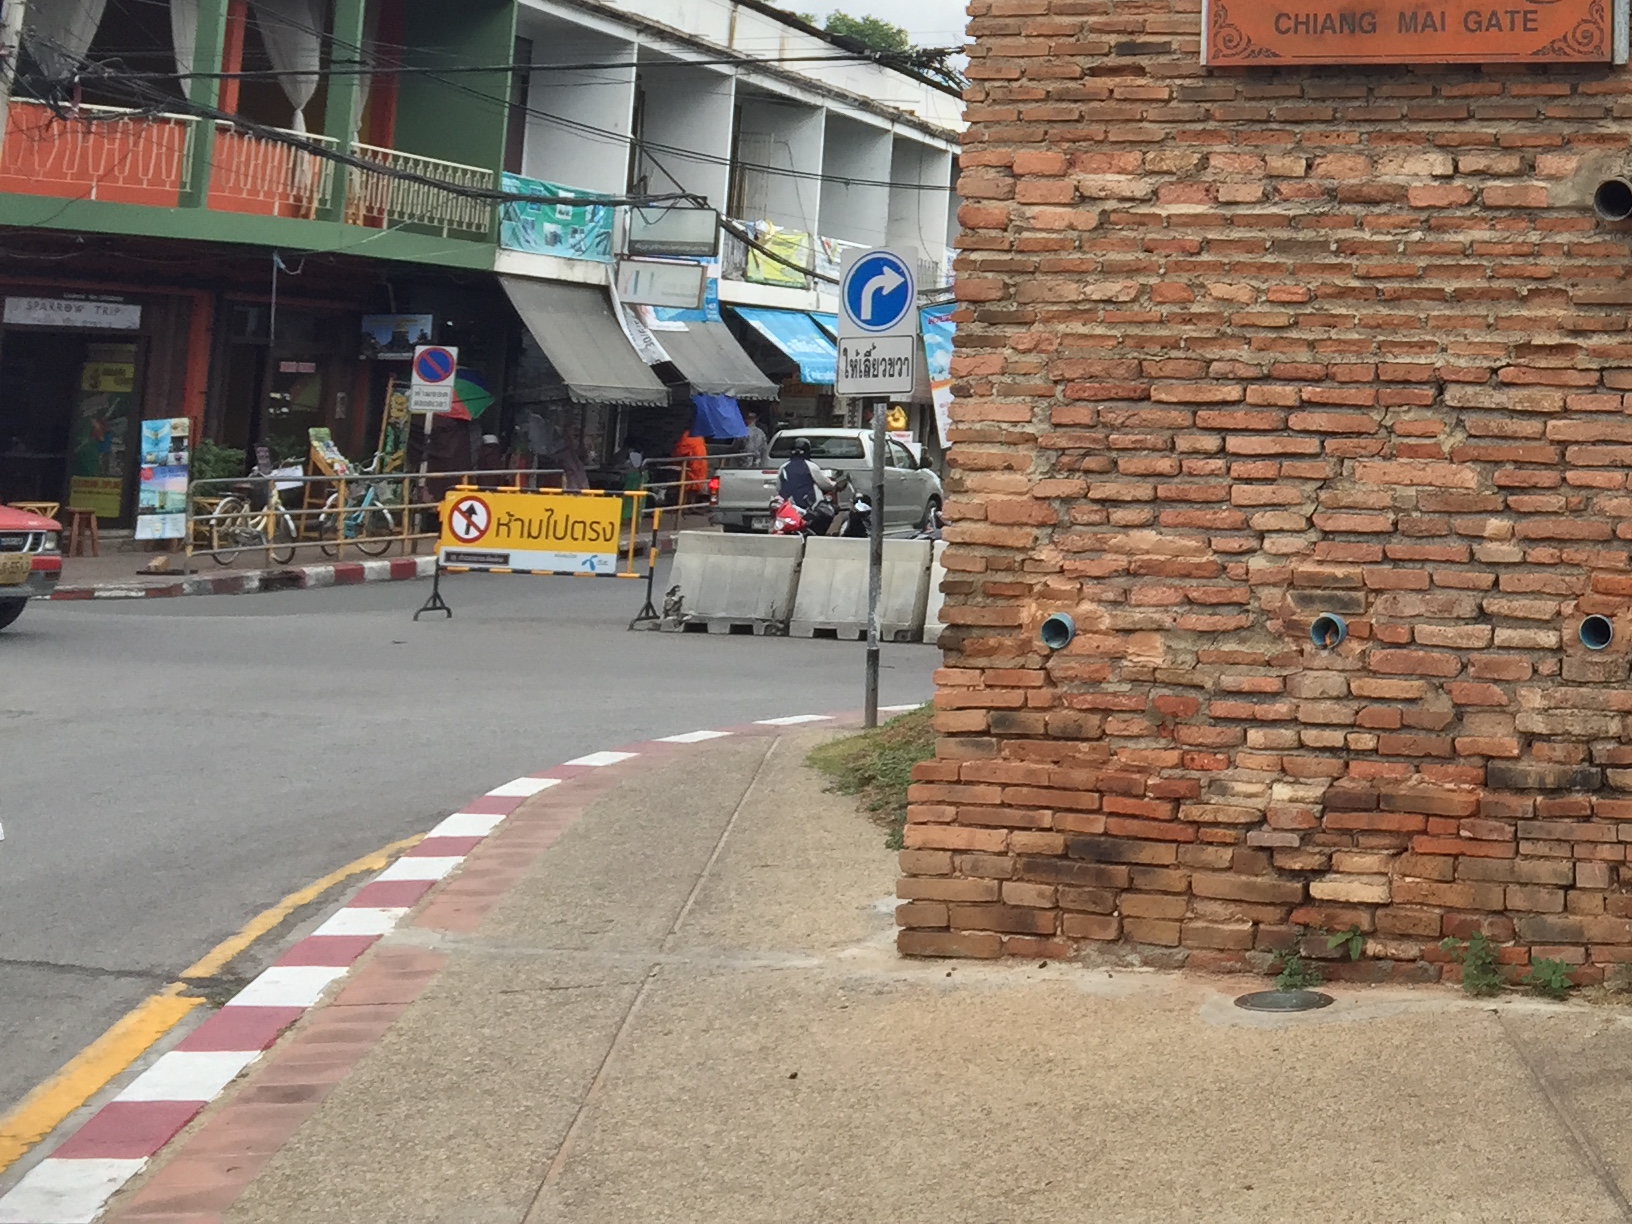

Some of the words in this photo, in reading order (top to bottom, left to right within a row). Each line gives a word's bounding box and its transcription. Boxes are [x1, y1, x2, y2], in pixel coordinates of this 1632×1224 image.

[1274, 11, 1378, 35] CHIANG
[1399, 11, 1447, 34] MAI
[1463, 9, 1539, 33] GATE
[25, 300, 85, 314] SPARROW
[94, 305, 122, 316] TRIP
[842, 342, 910, 379] ให้เลี้ยวขวา
[495, 508, 615, 543] ห้ามไปตรง
